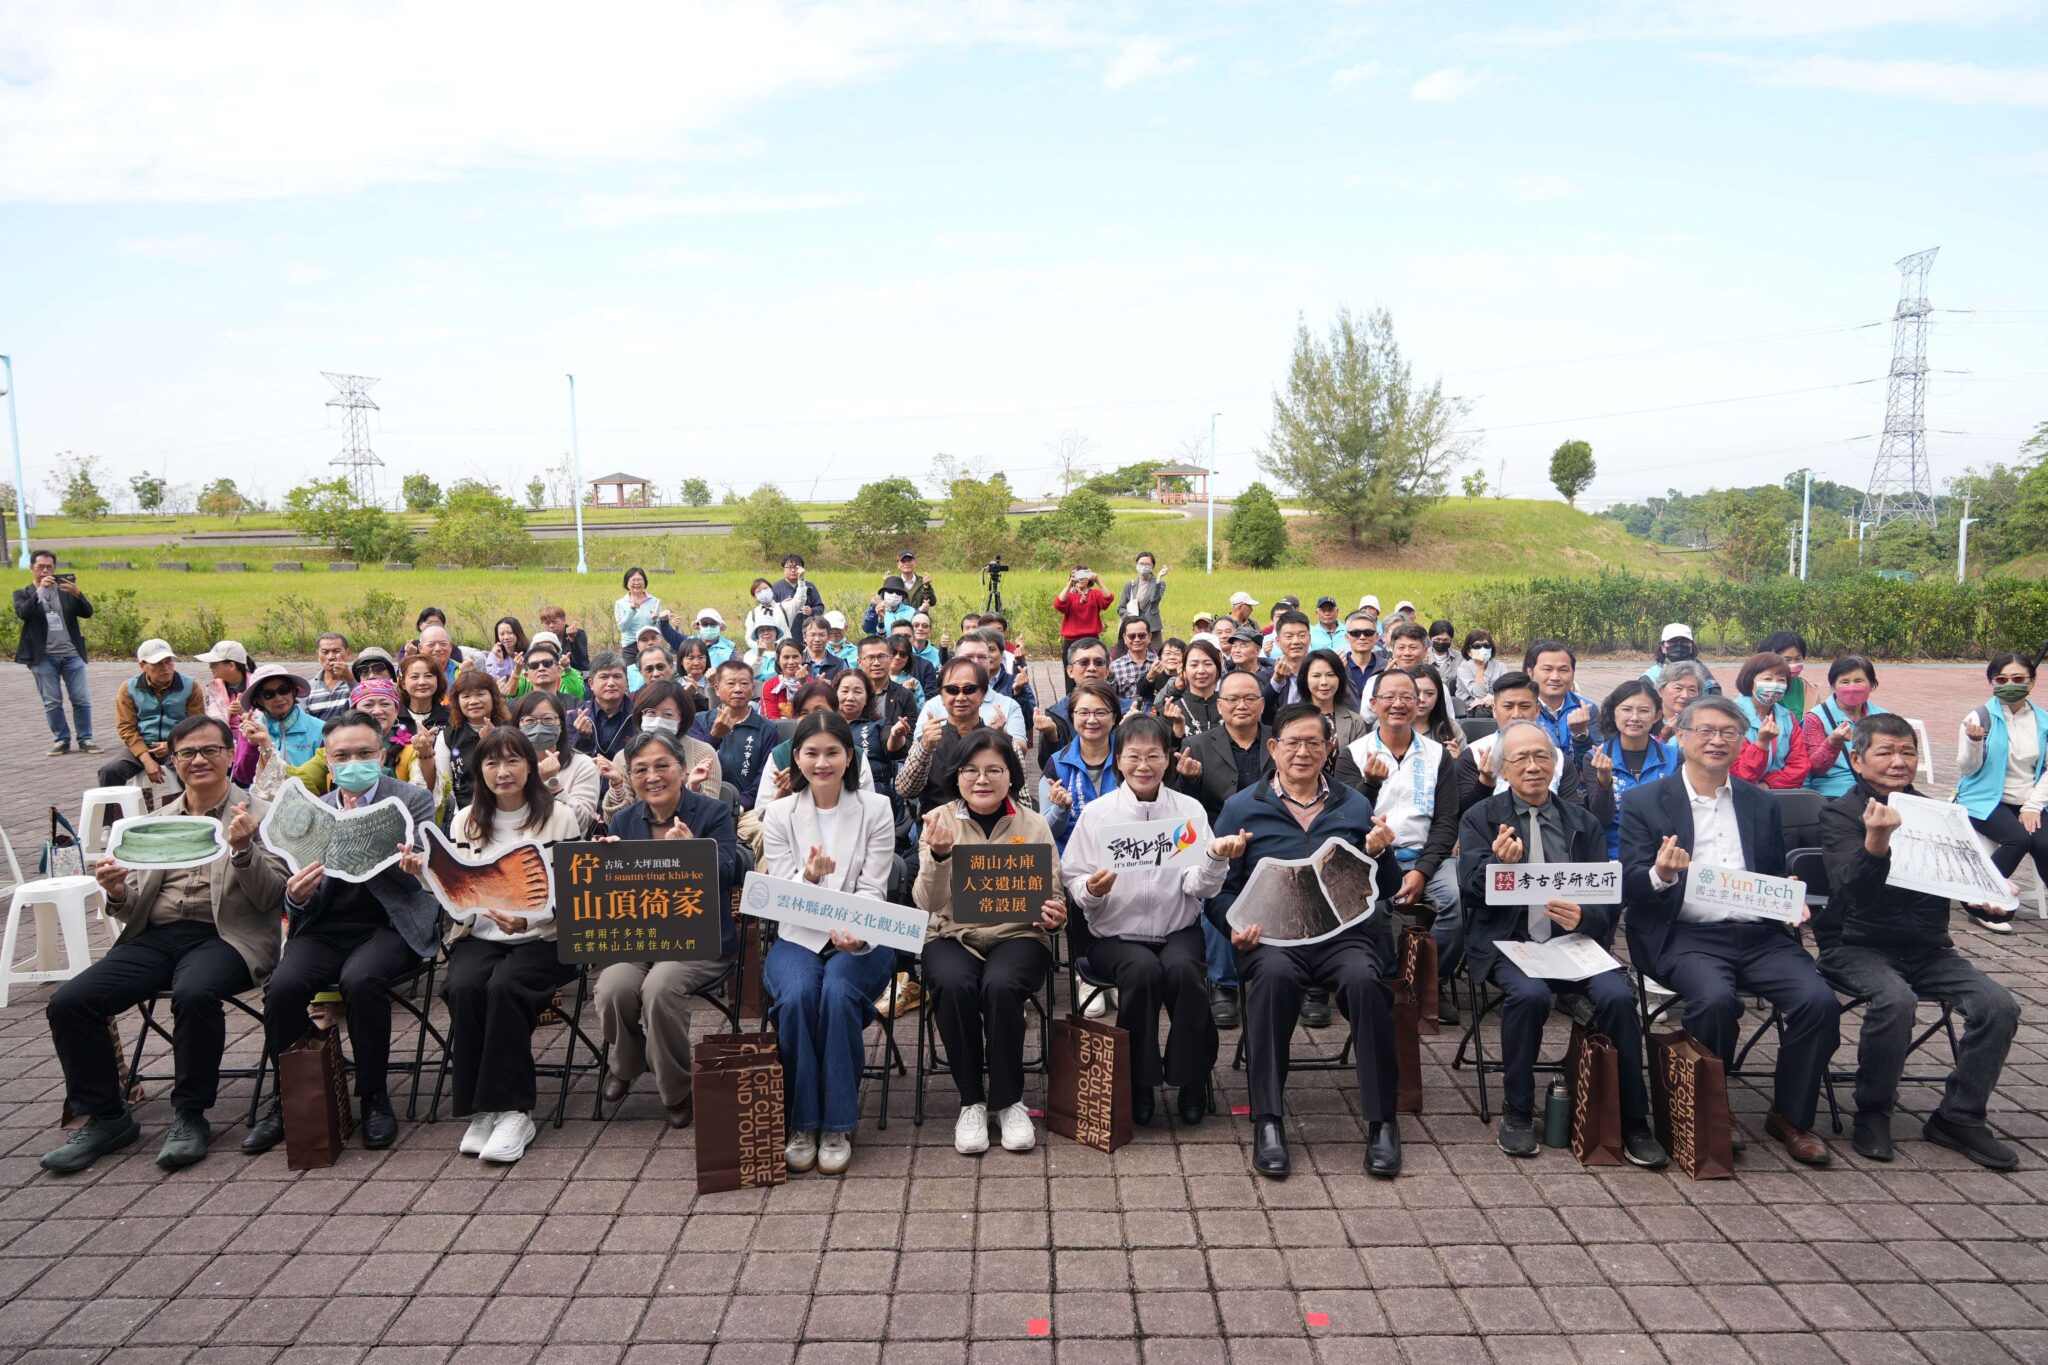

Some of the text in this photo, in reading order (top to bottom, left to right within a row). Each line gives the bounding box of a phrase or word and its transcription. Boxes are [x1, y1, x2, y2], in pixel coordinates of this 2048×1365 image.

[569, 853, 600, 885] 佇
[970, 854, 1035, 870] 湖山水庫
[1518, 871, 1617, 890] 考古學研究所
[963, 875, 1043, 892] 人文遺址館
[1695, 885, 1793, 912] 國立雲林科技大學
[1720, 872, 1794, 900] YunTech
[777, 894, 922, 939] 雲林縣政府文化觀光處
[979, 897, 1028, 913] 常設展
[573, 939, 696, 953] 在雲林山上居住的人們
[754, 1073, 769, 1095] OF
[1075, 1029, 1091, 1145] AND TOURISM
[1088, 1038, 1102, 1145] OF CULTURE
[1100, 1035, 1114, 1154] DEPARTMENT
[738, 1070, 757, 1189] AND TOURISM
[770, 1066, 786, 1184] DEPARTMENT
[1676, 1055, 1687, 1168] OF CULTURE
[1685, 1058, 1696, 1180] DEPARTMENT
[754, 1100, 772, 1183] CULTURE
